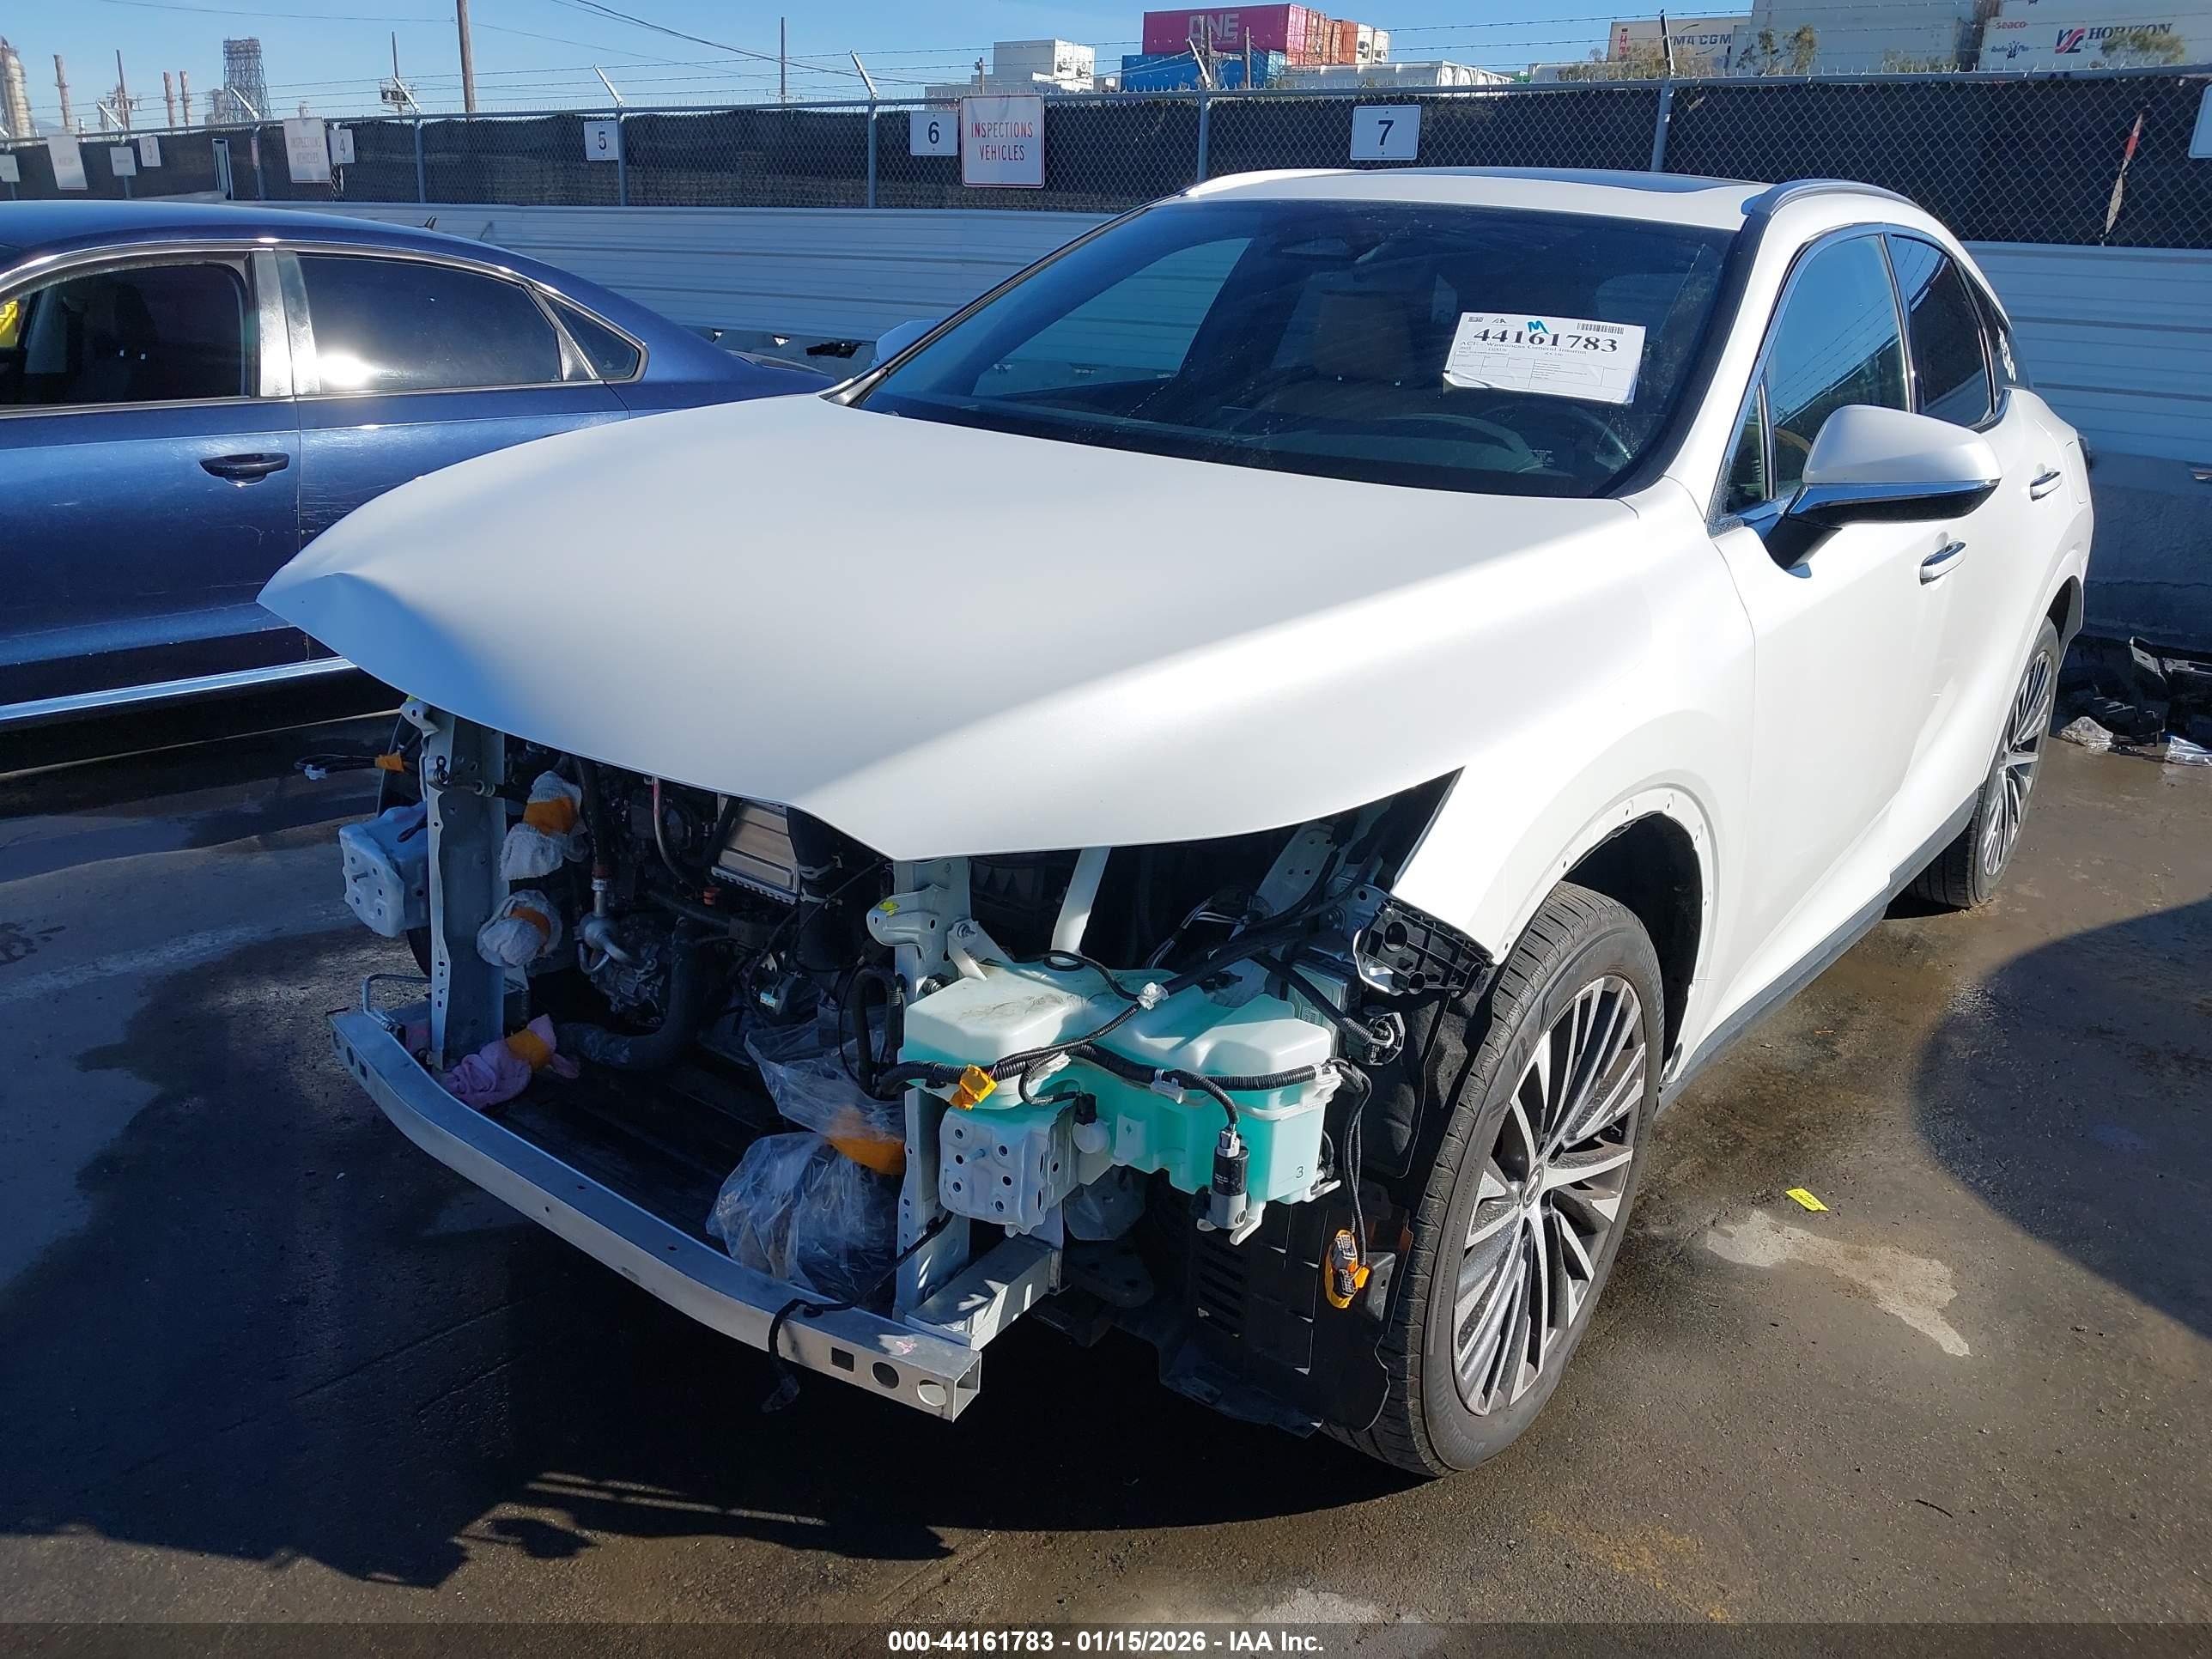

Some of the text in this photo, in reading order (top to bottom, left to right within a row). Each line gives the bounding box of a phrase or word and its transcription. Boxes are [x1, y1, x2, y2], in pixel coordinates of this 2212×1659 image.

[1189, 13, 1239, 38] ONE
[2087, 23, 2173, 40] HORIZON
[1700, 34, 1732, 45] CGM
[927, 121, 940, 144] 6
[971, 122, 1033, 138] INSPECTIONS
[1377, 119, 1395, 146] 7
[339, 138, 346, 155] 4
[598, 131, 607, 150] 5
[979, 145, 1024, 161] VEHICLES
[1473, 328, 1618, 353] 44161783
[1296, 1166, 1304, 1179] 3
